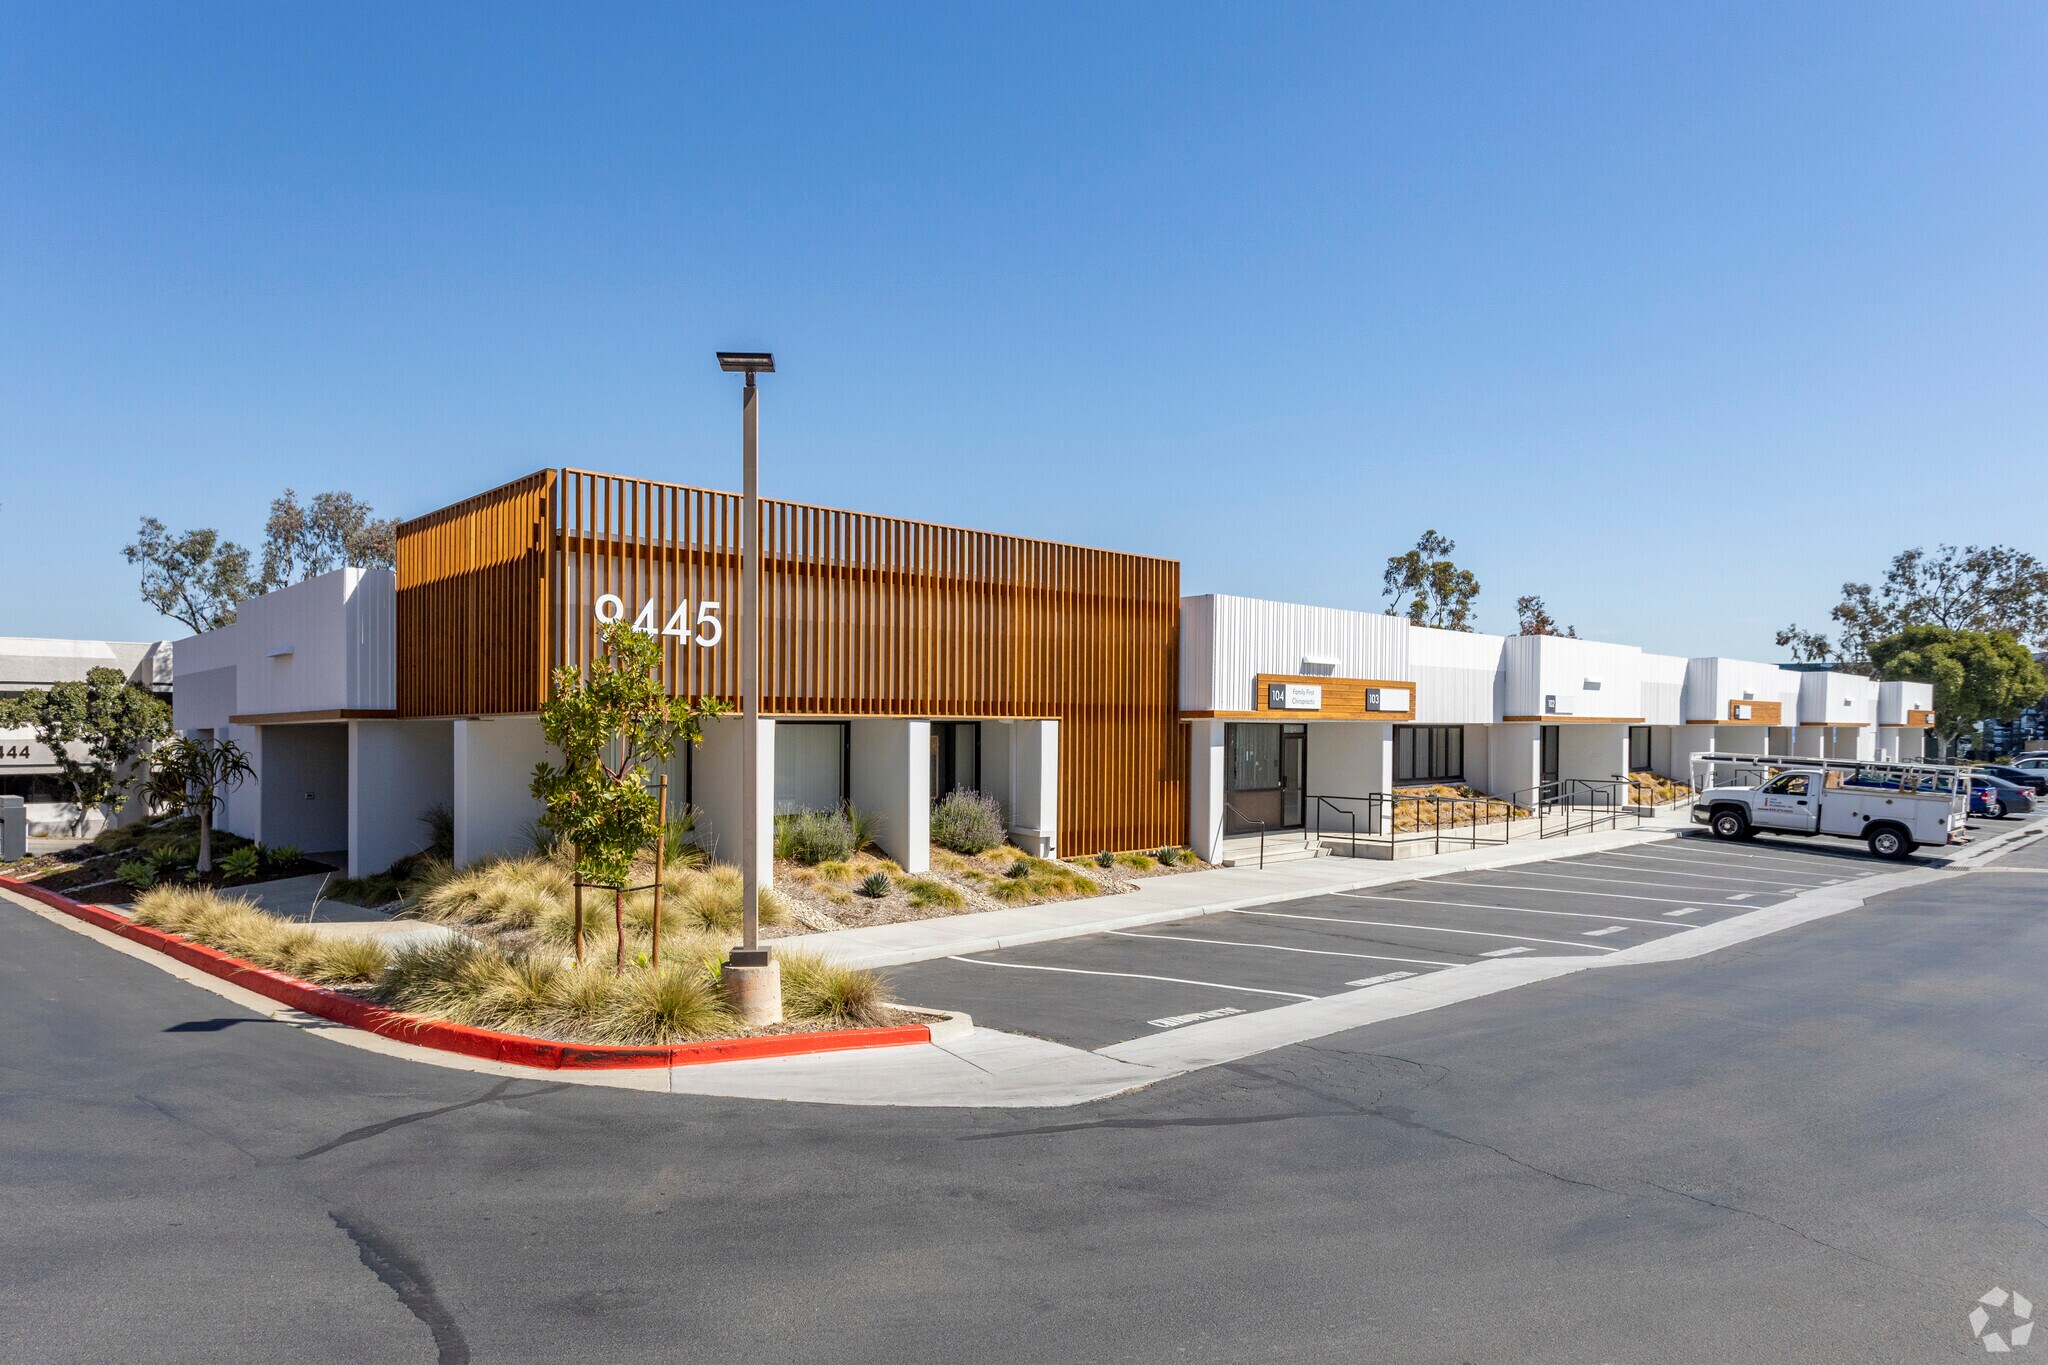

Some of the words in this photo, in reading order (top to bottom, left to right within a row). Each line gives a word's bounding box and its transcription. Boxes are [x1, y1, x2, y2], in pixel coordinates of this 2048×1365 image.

[595, 593, 723, 648] 9445
[1272, 690, 1284, 701] 104
[1292, 688, 1305, 696] Family
[1306, 688, 1315, 696] First
[1292, 697, 1315, 705] Chiropractic
[1369, 694, 1380, 704] 103
